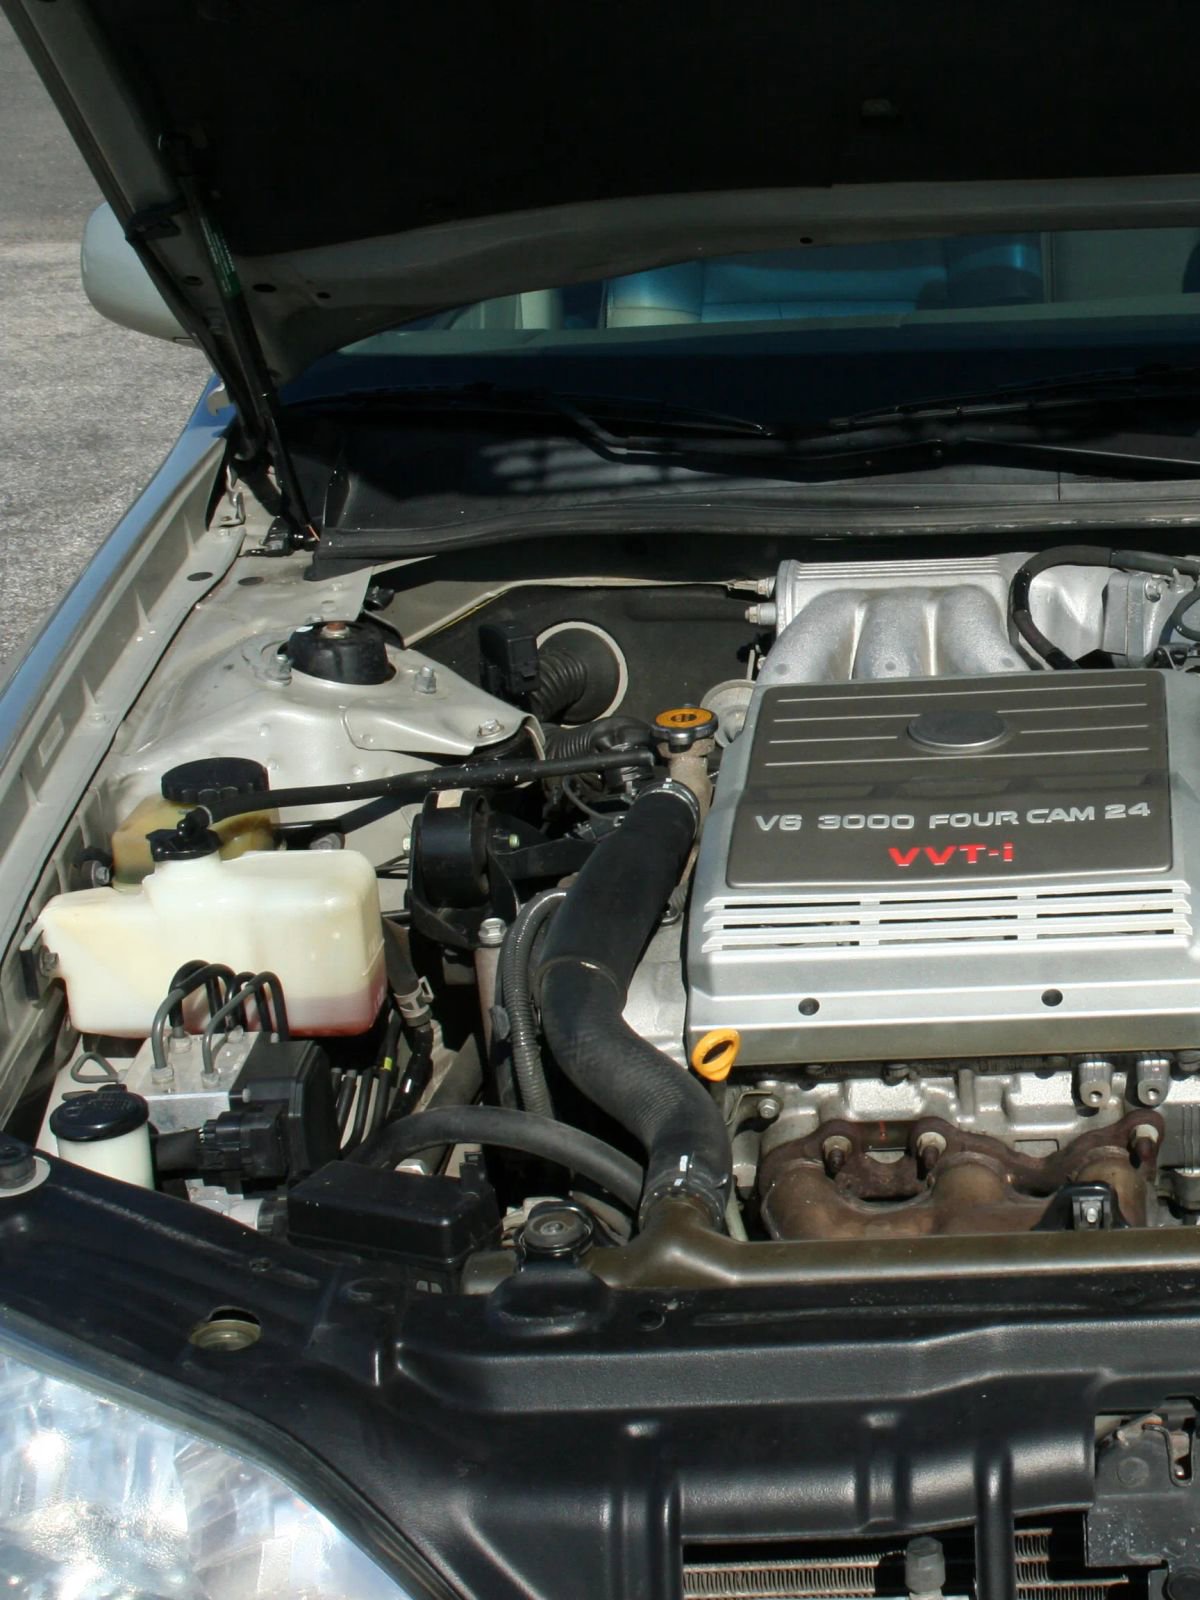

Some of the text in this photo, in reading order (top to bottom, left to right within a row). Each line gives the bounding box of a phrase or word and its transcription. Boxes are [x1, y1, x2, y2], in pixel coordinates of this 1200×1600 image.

[755, 802, 1151, 831] V6 3000 FOUR CAM 24
[888, 842, 1014, 866] VVT-i
